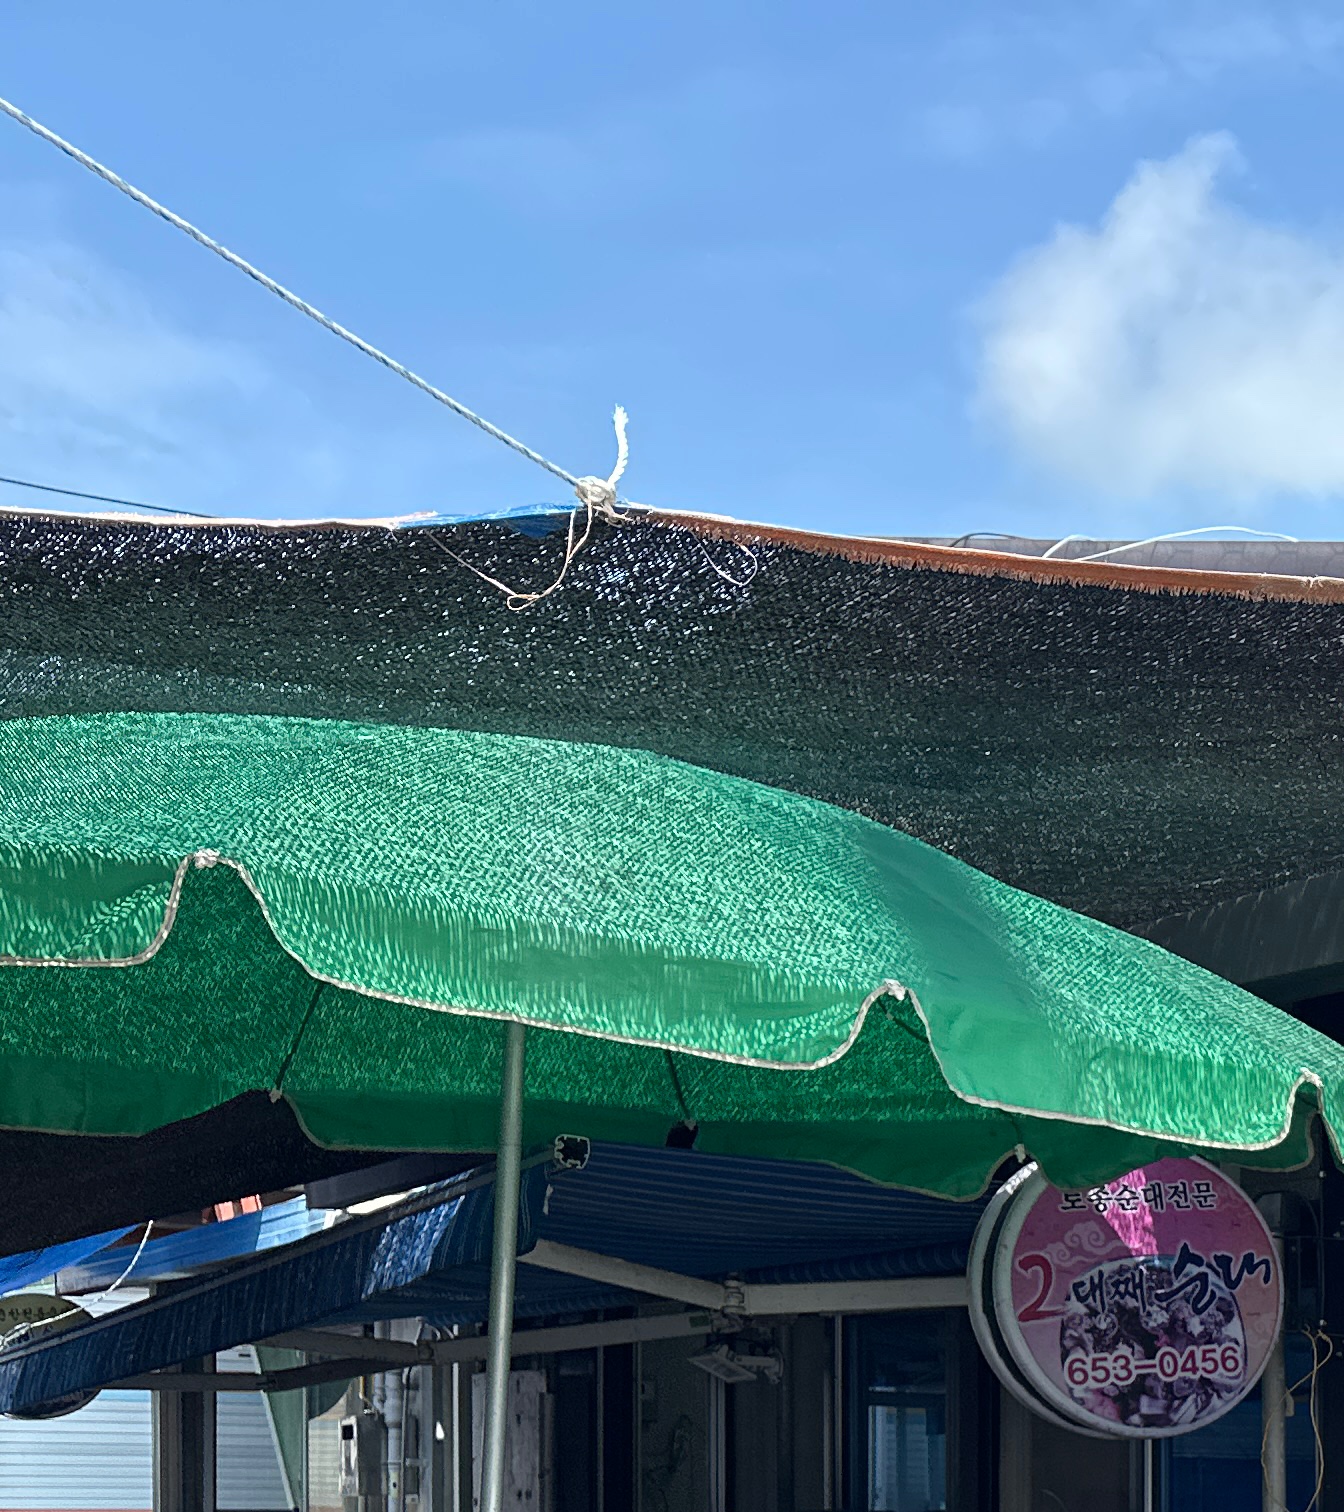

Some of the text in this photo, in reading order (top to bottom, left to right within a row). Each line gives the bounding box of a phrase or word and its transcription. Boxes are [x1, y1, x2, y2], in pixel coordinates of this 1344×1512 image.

[1018, 1242, 1272, 1322] 2대째 순대
[1067, 1347, 1241, 1386] 653-0456
